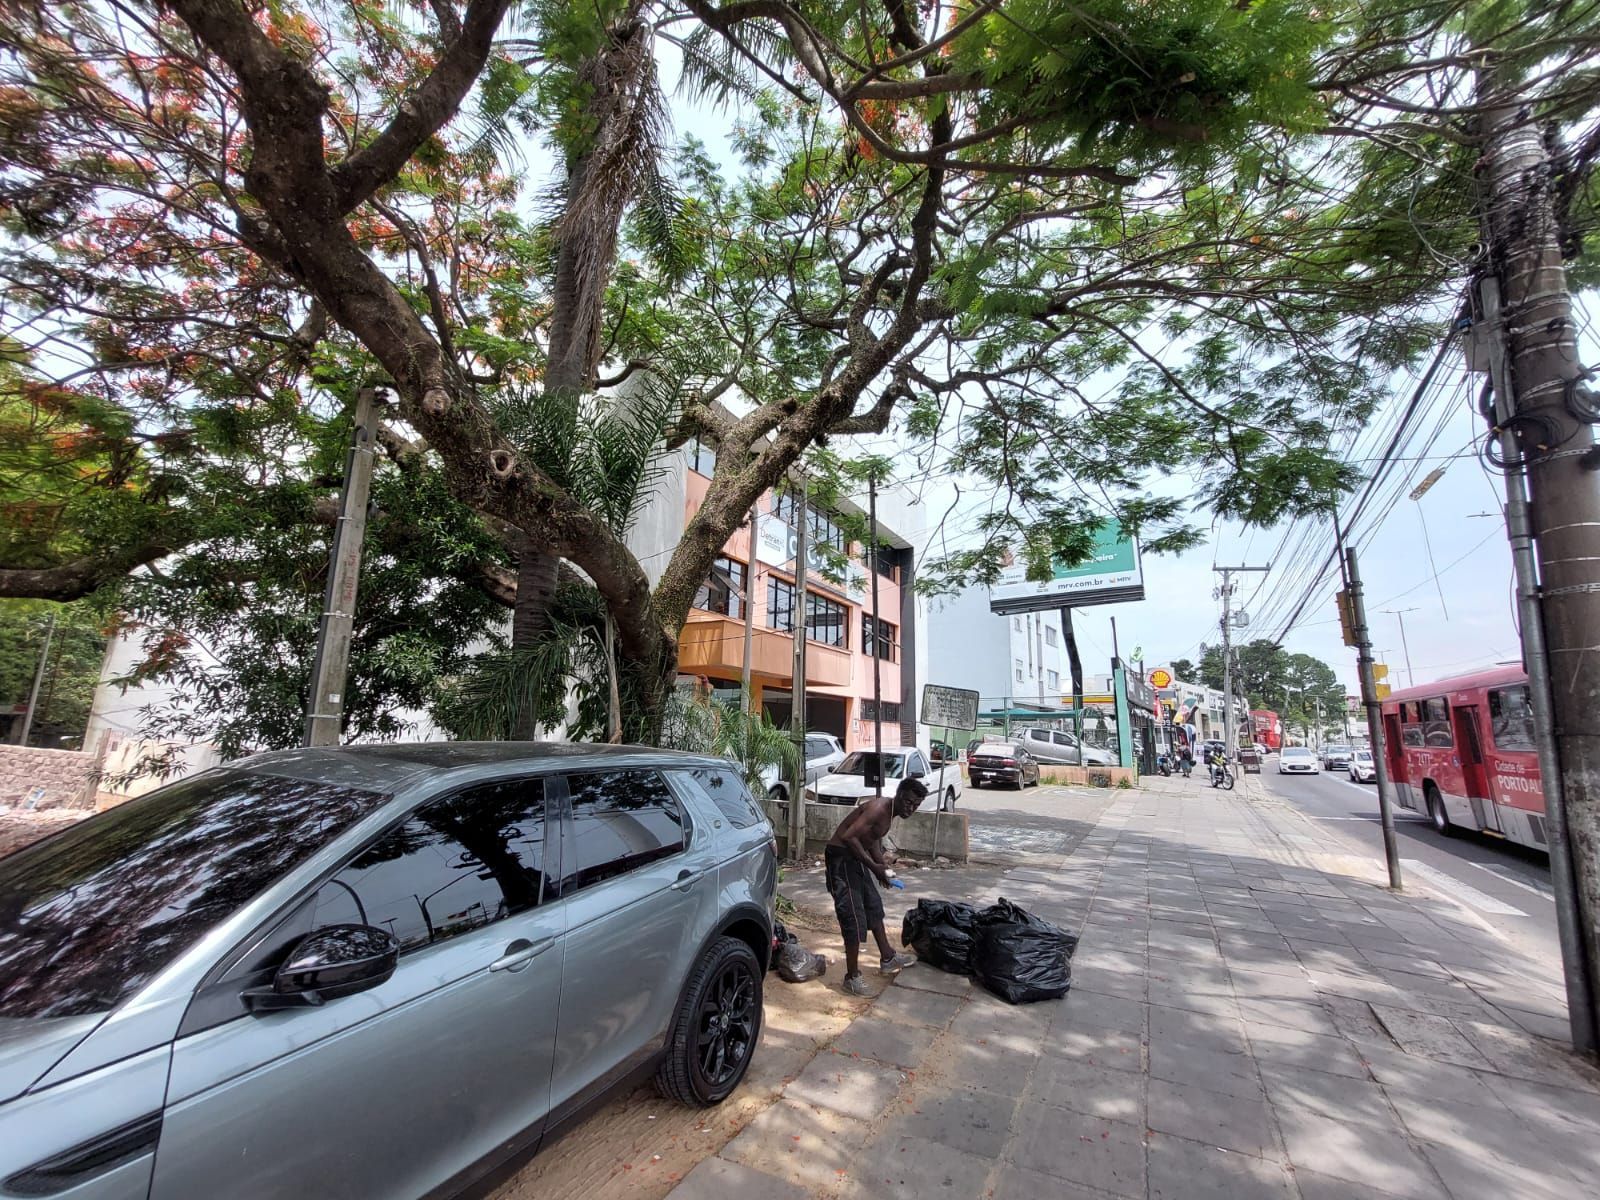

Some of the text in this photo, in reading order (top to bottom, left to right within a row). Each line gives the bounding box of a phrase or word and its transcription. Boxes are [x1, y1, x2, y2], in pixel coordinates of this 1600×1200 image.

[1058, 579, 1103, 590] mrv.com.br
[1495, 760, 1525, 774] Cidade de
[1497, 775, 1543, 795] PORTO AL
